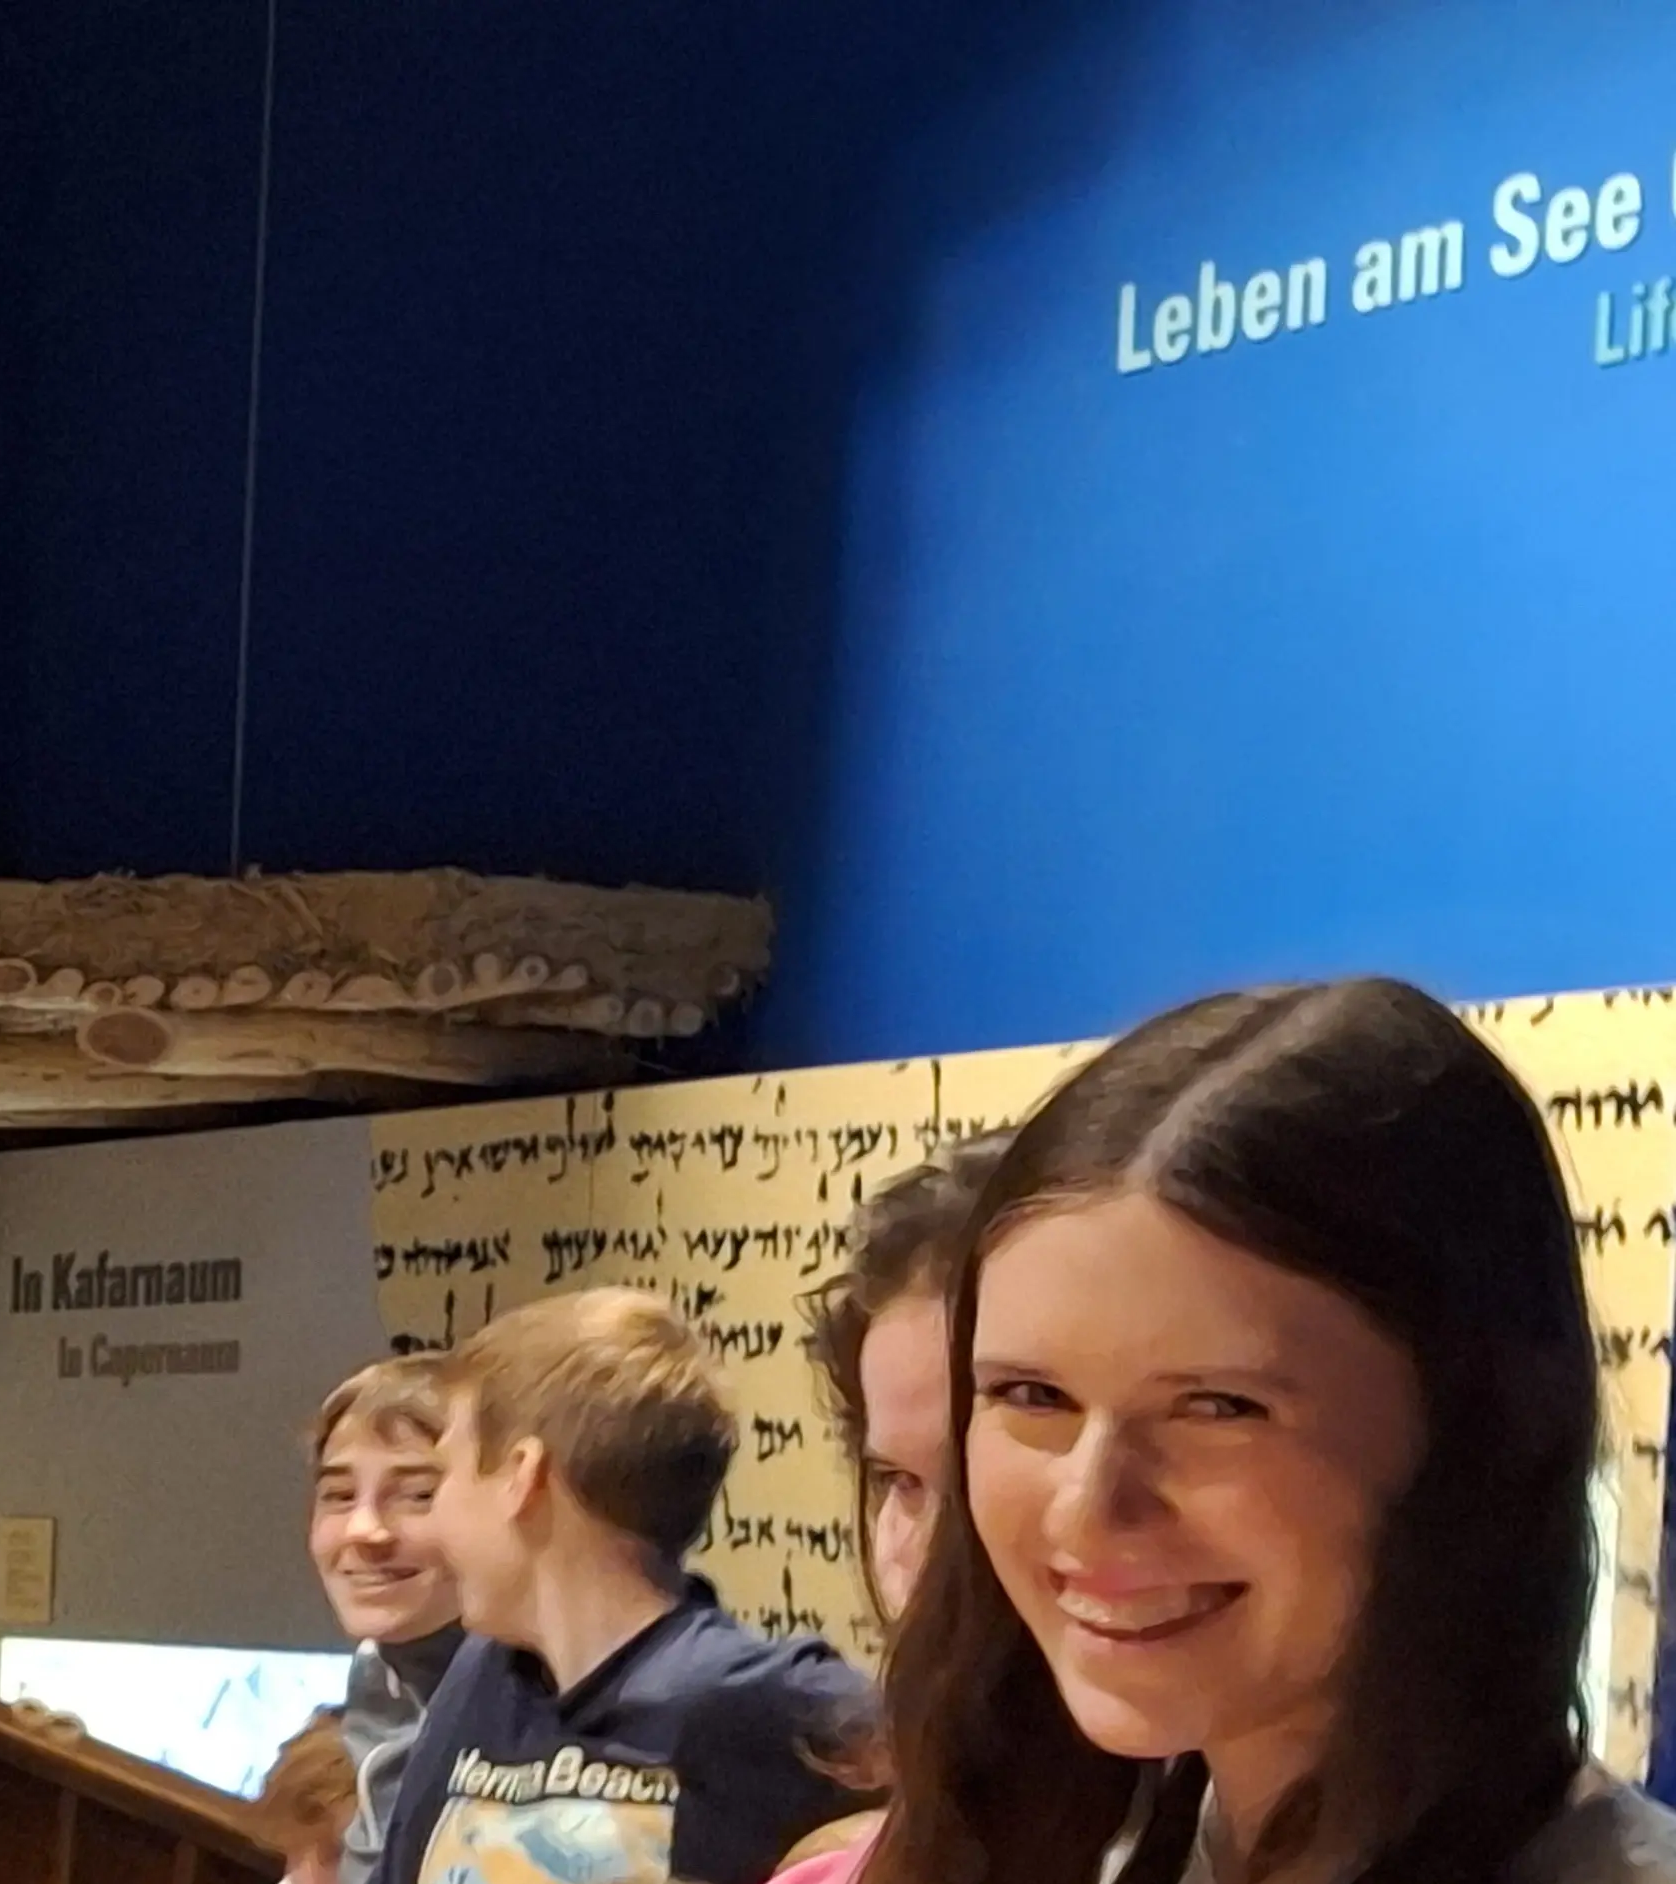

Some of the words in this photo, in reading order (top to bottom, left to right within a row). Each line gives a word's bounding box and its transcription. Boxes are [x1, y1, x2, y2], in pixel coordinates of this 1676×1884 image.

[1117, 259, 1327, 375] Leben
[1352, 220, 1464, 314] am
[1489, 172, 1643, 278] See
[10, 1255, 43, 1314] In
[52, 1249, 242, 1311] Kafarnaum
